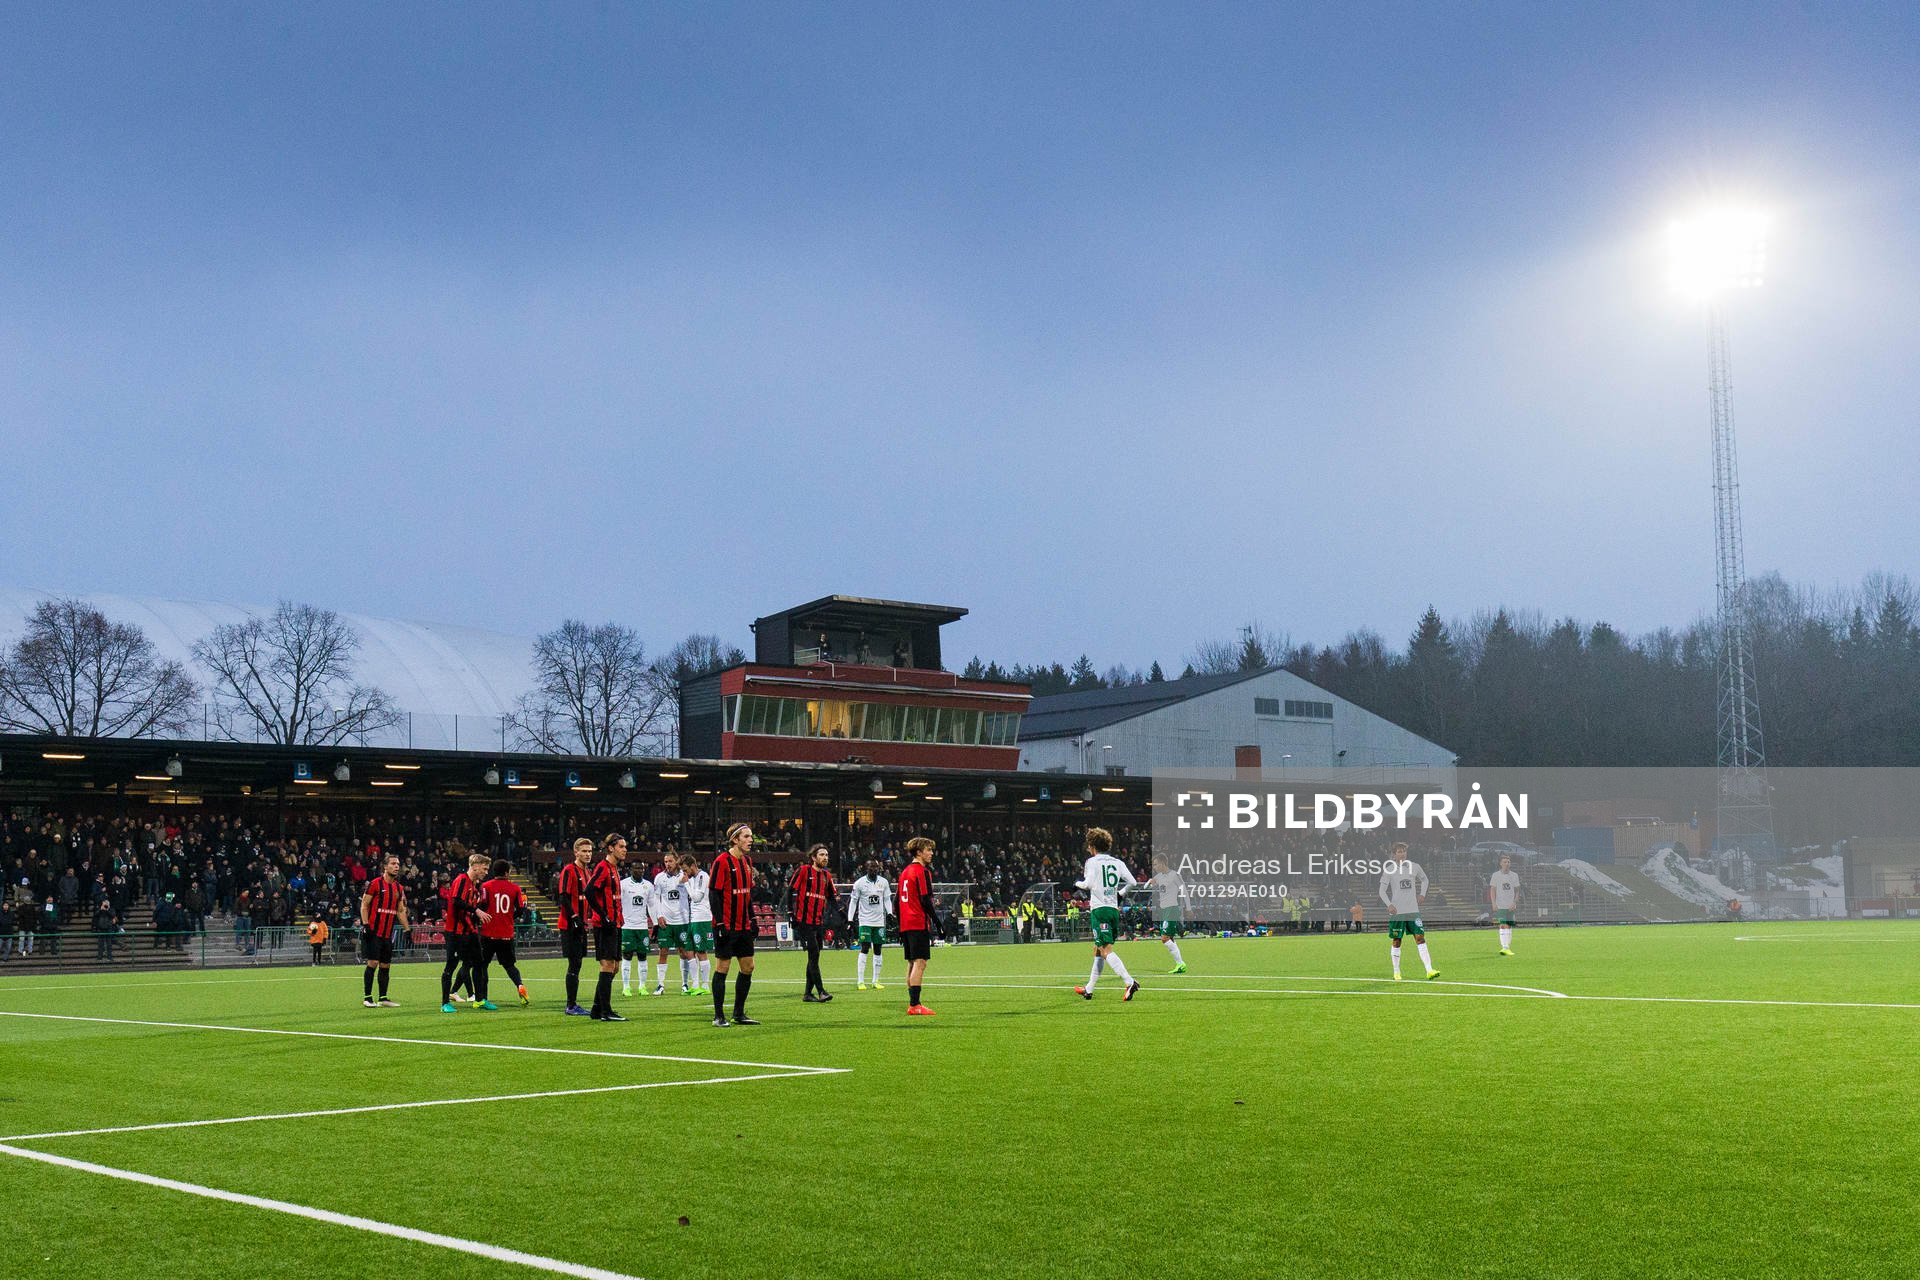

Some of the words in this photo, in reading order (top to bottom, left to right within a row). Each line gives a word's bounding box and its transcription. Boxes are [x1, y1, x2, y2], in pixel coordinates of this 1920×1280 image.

[297, 763, 307, 776] B
[508, 770, 516, 782] B
[568, 772, 576, 784] C
[1101, 864, 1118, 888] 16
[901, 880, 908, 903] 5
[494, 893, 510, 914] 10
